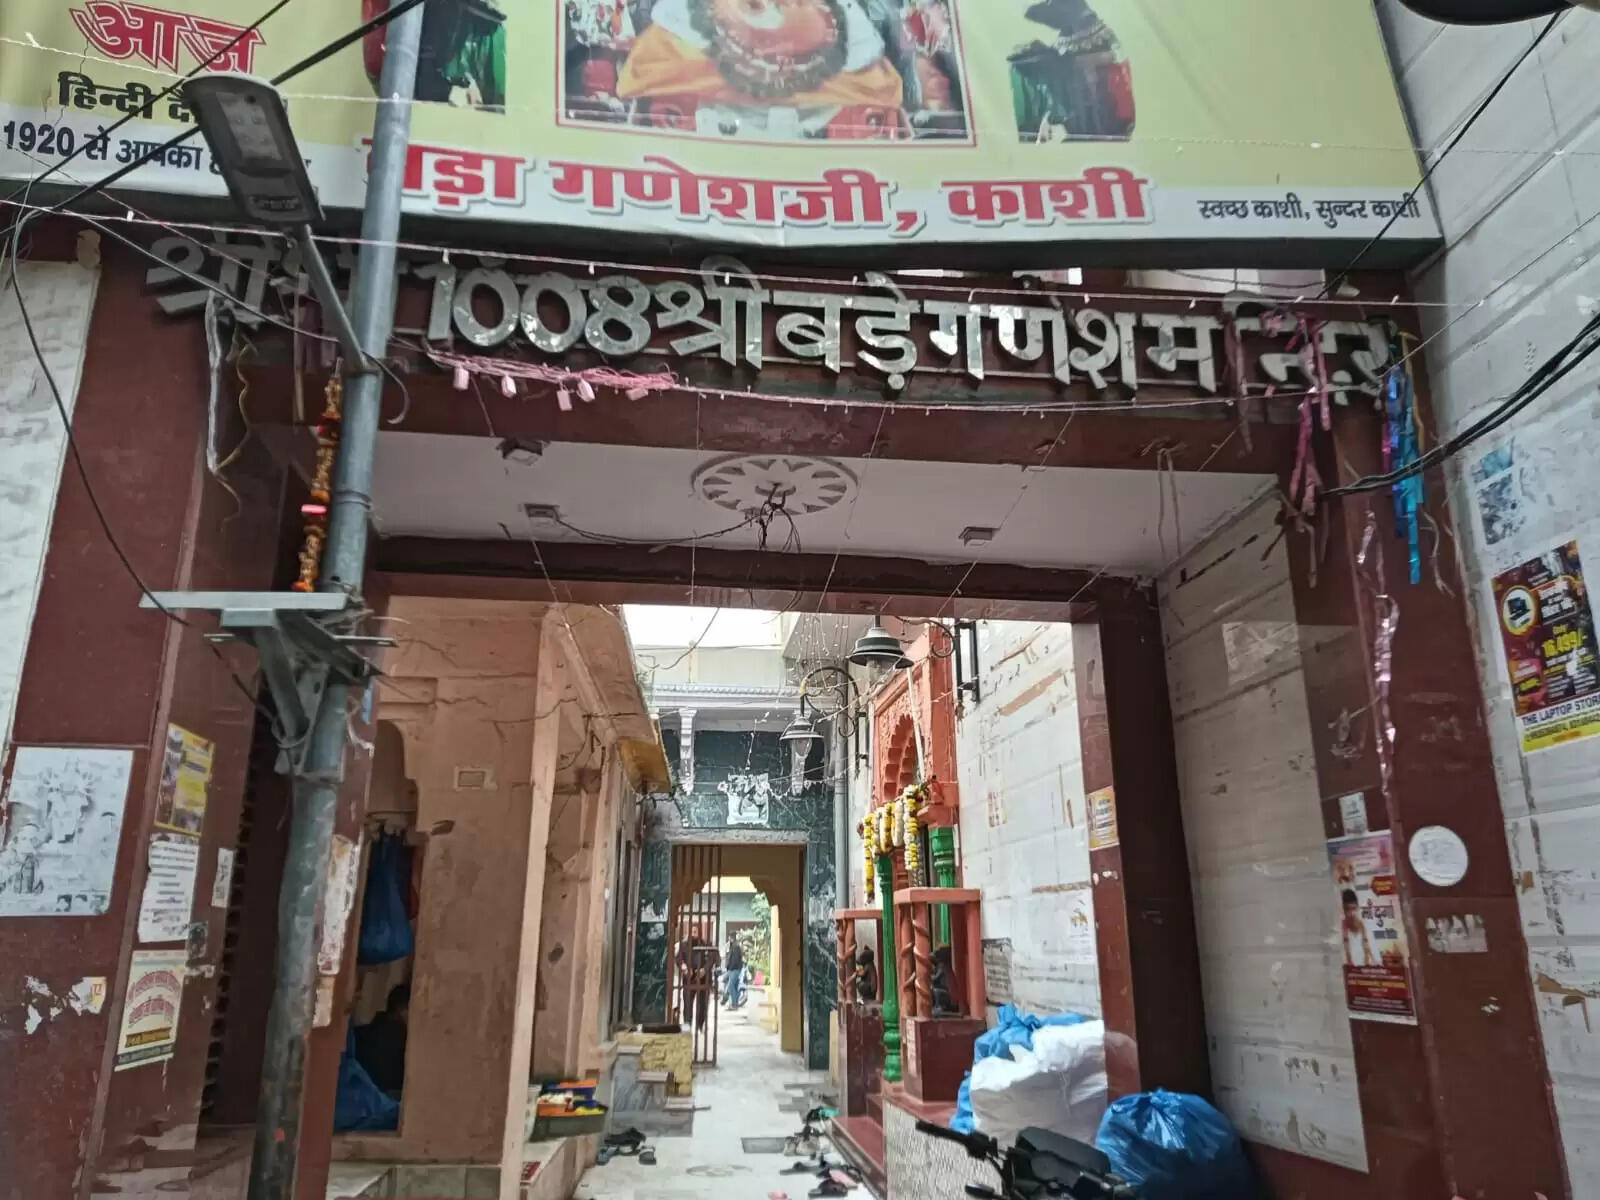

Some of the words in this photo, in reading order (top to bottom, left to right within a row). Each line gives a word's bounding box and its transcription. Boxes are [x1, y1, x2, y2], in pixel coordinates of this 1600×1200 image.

[69, 0, 266, 74] आज
[58, 71, 155, 119] हिन्दी
[3, 120, 74, 157] 1920
[83, 125, 111, 161] से
[549, 155, 917, 232] गणेशजी,
[941, 165, 1148, 221] काशी
[1197, 199, 1249, 219] स्वच्छ
[1251, 191, 1310, 221] काशी,
[1313, 199, 1369, 229] सुन्दर
[1369, 191, 1421, 219] काशी
[1539, 703, 1573, 721] LAPTOP
